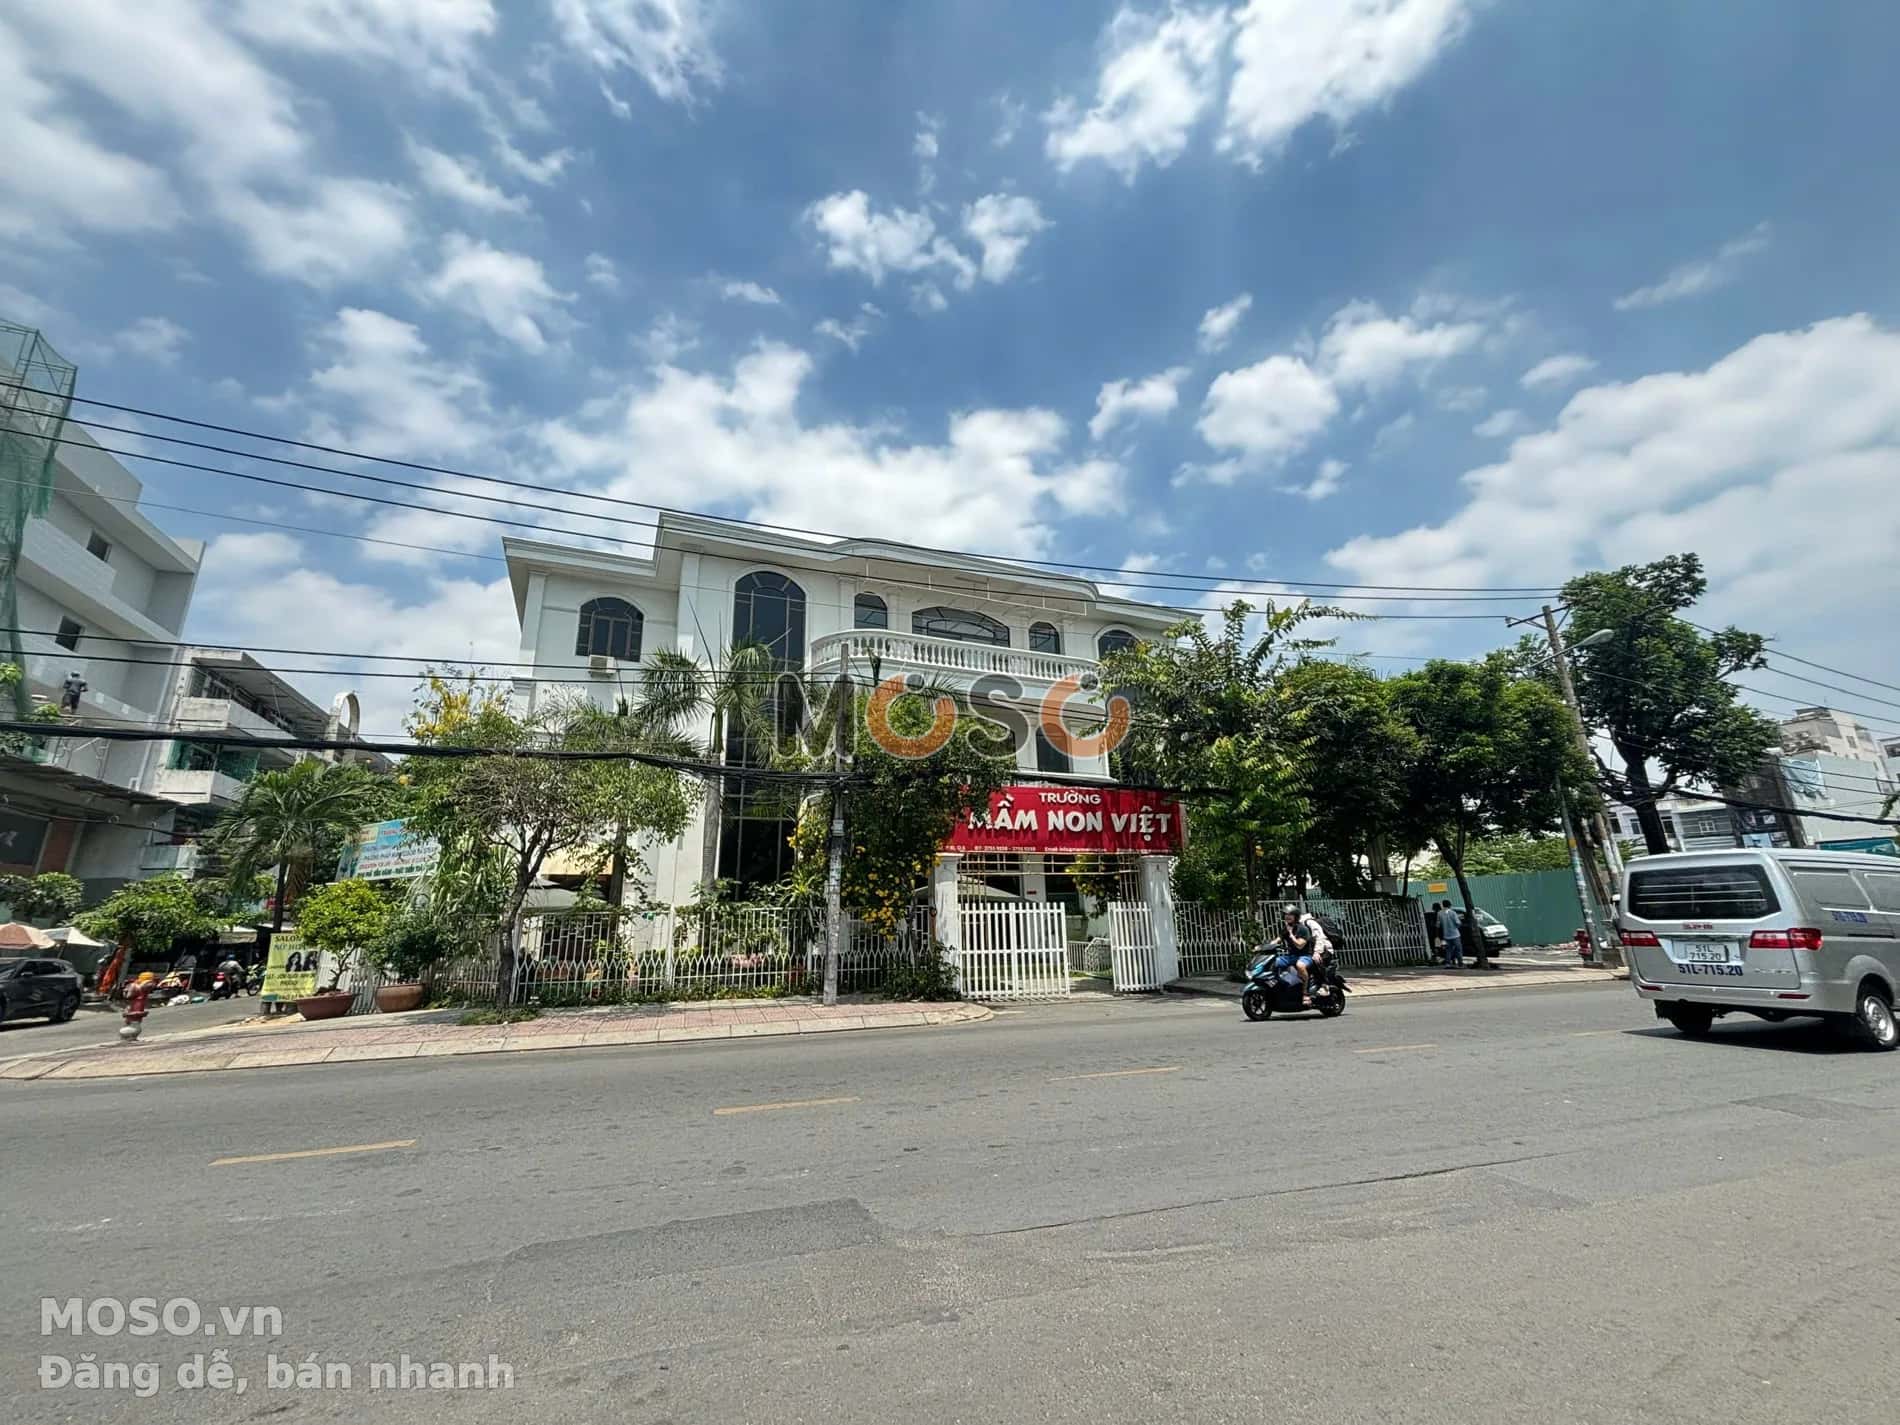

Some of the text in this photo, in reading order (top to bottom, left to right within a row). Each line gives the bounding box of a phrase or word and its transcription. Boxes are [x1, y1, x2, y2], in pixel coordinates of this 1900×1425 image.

[1039, 790, 1102, 805] TRƯỜNG
[1047, 809, 1103, 833] NON
[1111, 806, 1172, 841] VIỆT
[1695, 944, 1714, 952] 51L
[1690, 952, 1722, 960] 715.20
[1678, 963, 1744, 976] 51L-715.20
